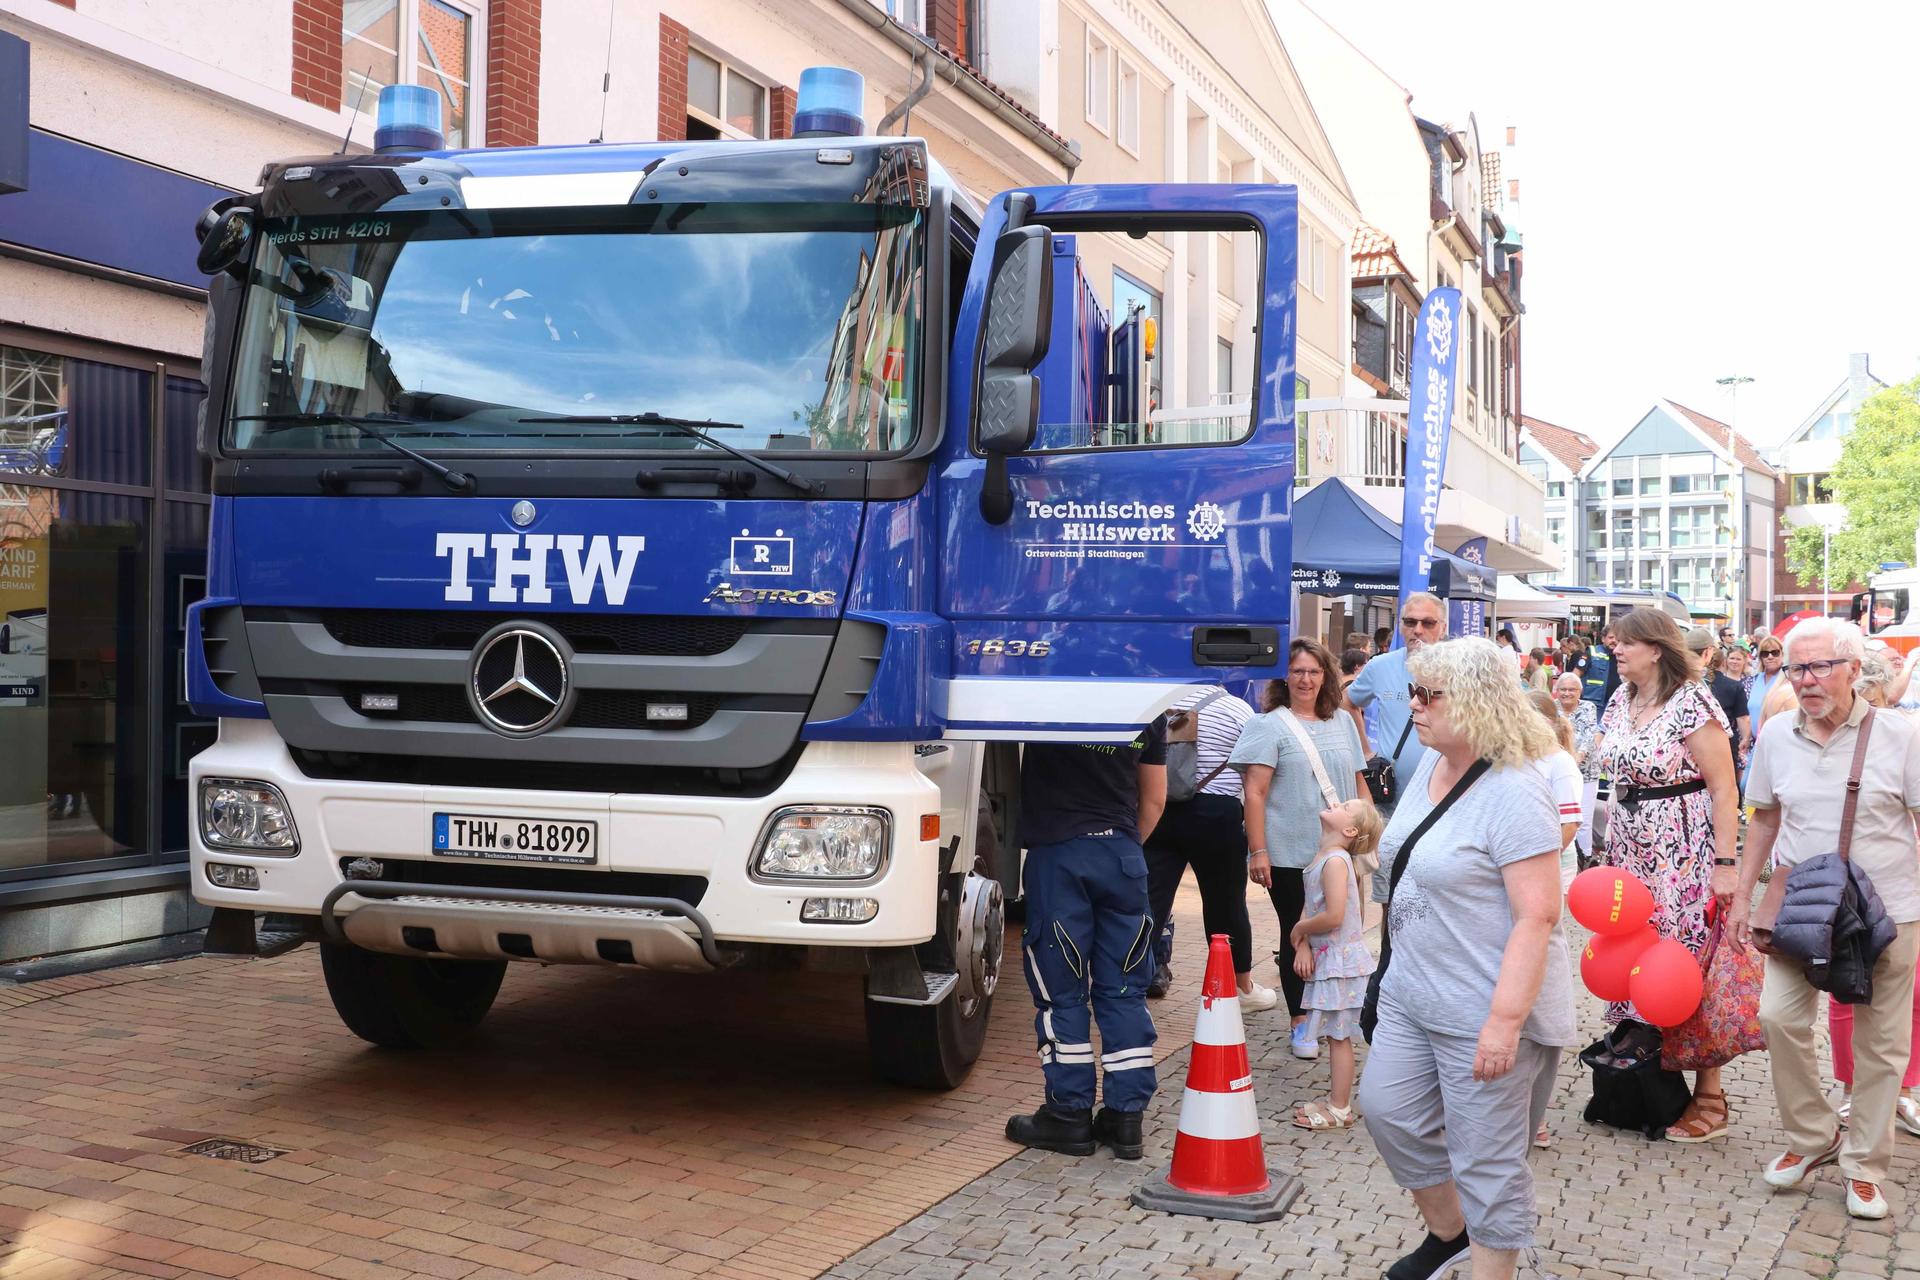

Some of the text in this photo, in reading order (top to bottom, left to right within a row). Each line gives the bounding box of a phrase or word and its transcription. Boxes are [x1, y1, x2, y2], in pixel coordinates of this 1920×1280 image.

[268, 221, 391, 246] Heros STH 42/61
[1418, 365, 1440, 577] Technisches
[1026, 501, 1175, 519] Technisches
[1063, 523, 1175, 541] Hilfswerk
[754, 544, 770, 563] R
[1025, 550, 1145, 560] Ortsverband Stadthagen
[435, 532, 645, 606] THW
[968, 639, 1051, 657] 1836
[12, 687, 35, 695] KIND
[439, 835, 445, 843] D
[453, 819, 590, 853] THW 81899
[1609, 879, 1623, 922] DLRG
